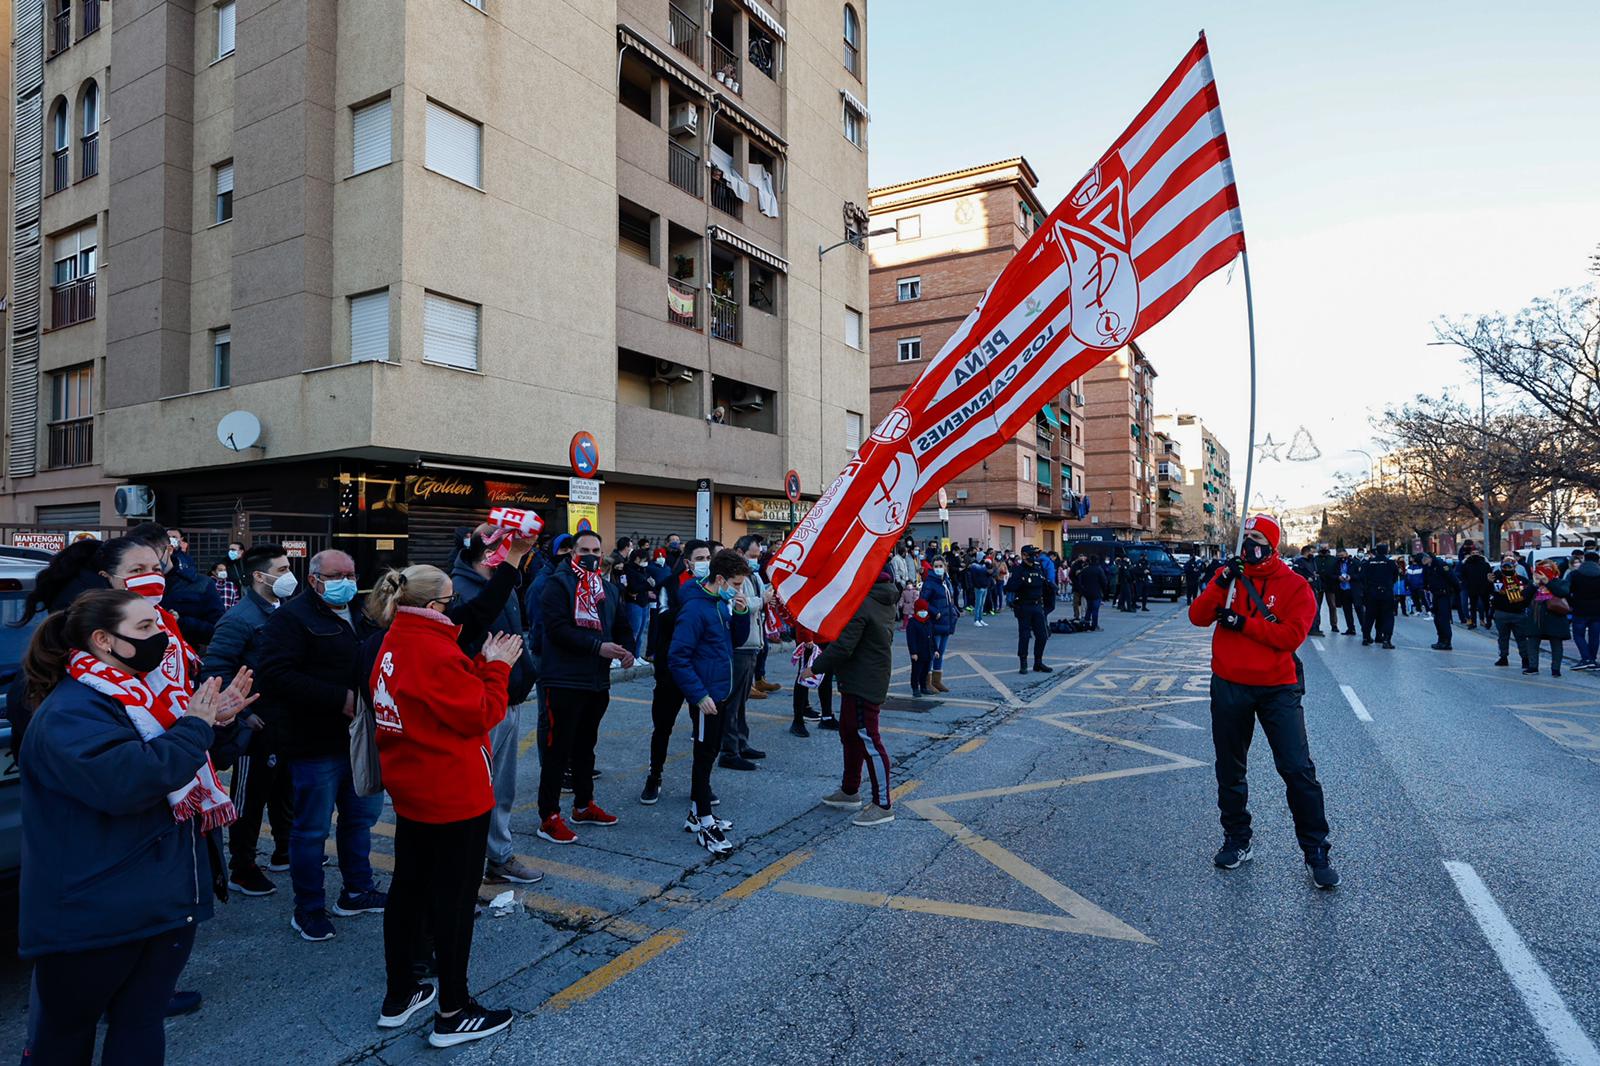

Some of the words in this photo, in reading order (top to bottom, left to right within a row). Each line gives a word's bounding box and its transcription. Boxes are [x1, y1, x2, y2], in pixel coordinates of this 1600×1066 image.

[414, 476, 473, 500] Golden
[763, 500, 808, 512] PANADRIA
[763, 511, 803, 522] BOLLERI
[15, 535, 64, 543] MANTENGAN
[29, 542, 60, 550] PORTON
